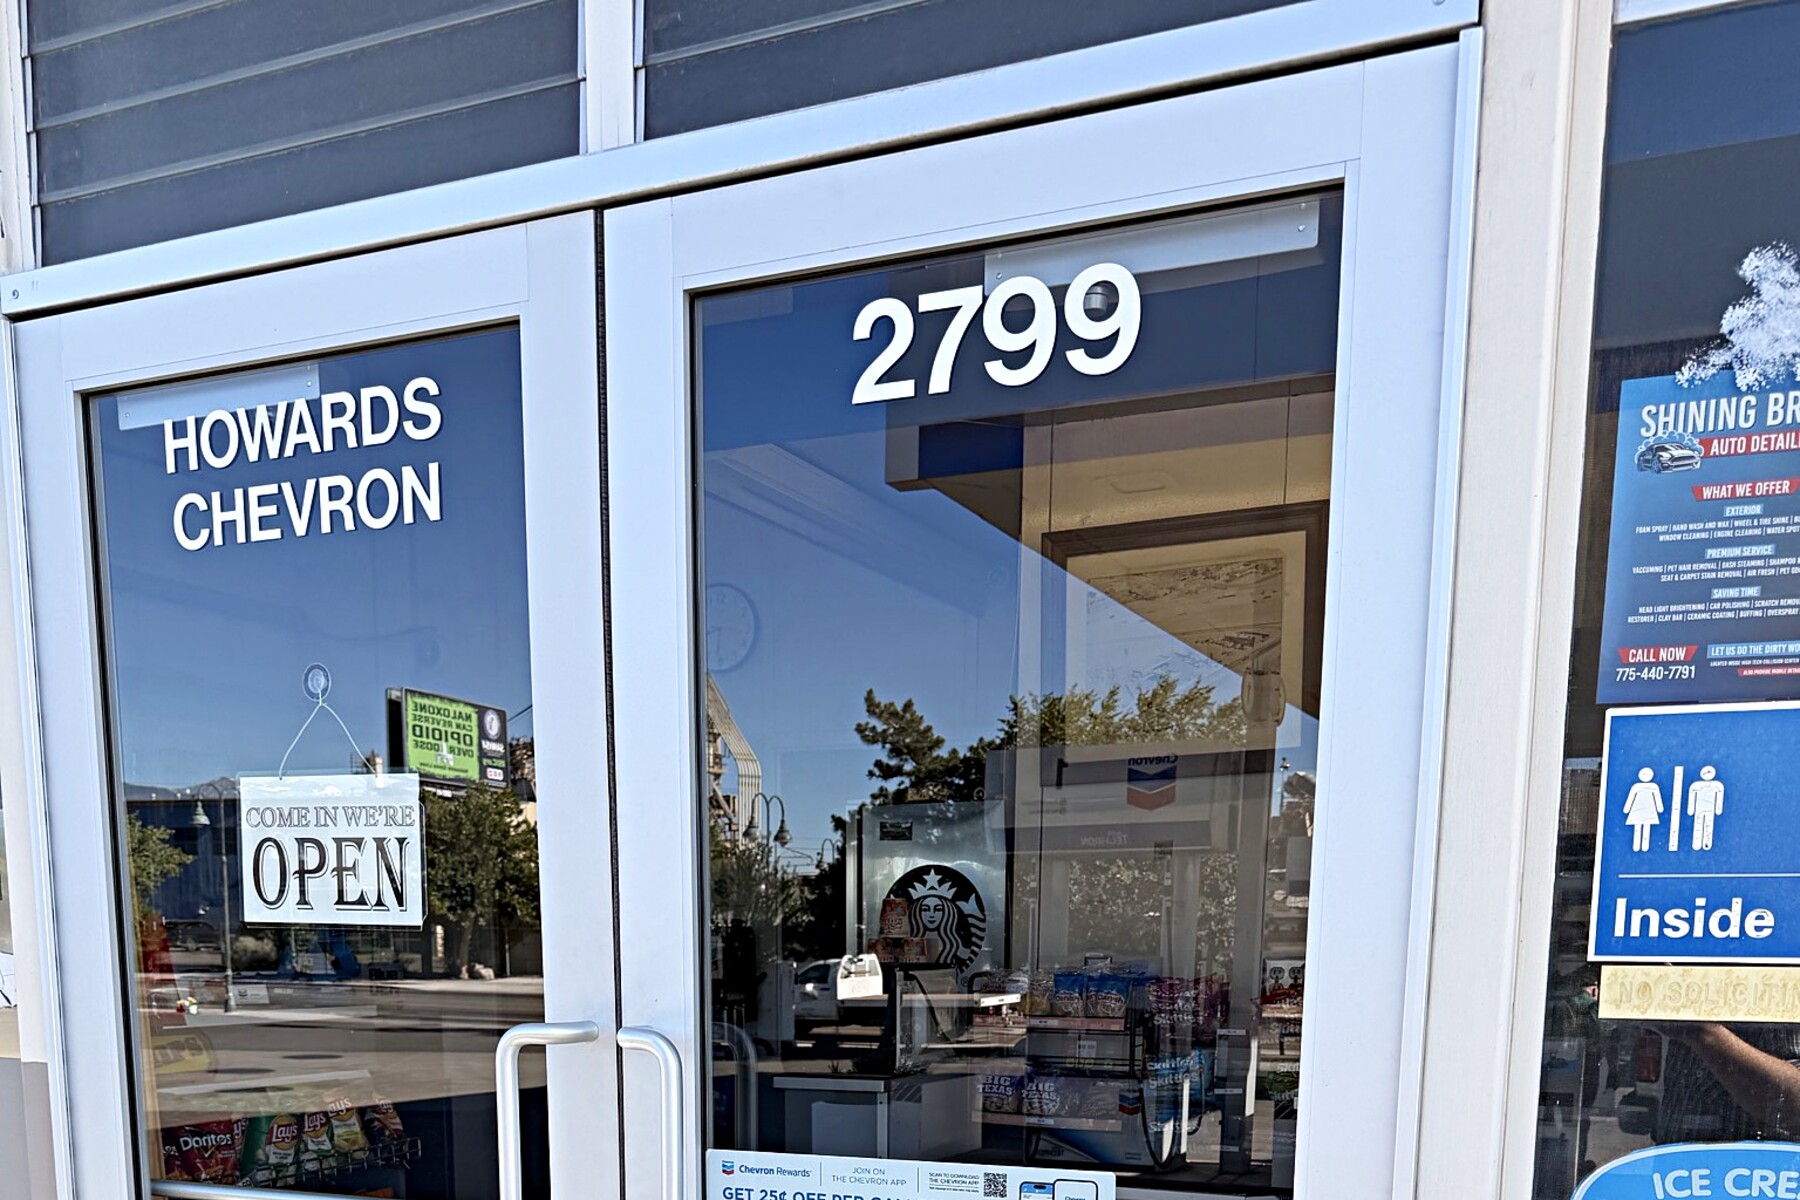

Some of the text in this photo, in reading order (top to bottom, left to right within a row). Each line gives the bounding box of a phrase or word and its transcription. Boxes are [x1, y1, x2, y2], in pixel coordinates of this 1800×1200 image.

[852, 262, 1142, 405] 2799
[1640, 395, 1758, 437] SHINING
[164, 377, 442, 475] HOWARDS
[1710, 436, 1747, 456] AUTO
[1702, 480, 1790, 500] WHAT WE OFFER
[173, 462, 441, 551] CHEVRON
[1726, 505, 1761, 516] EXTERIOR
[1707, 545, 1774, 559] PREMIUM SERVICE
[1713, 586, 1759, 599] SAVING TIME
[1628, 646, 1687, 663] CALL NOW
[1711, 646, 1724, 656] LET
[1725, 646, 1736, 655] US
[1737, 645, 1747, 655] DO
[1749, 645, 1763, 654] THE
[1764, 644, 1786, 653] DIRTY
[1615, 664, 1696, 682] 775-440-7791
[246, 805, 416, 828] COME IN WE'RE
[253, 836, 410, 912] OPEN
[1614, 897, 1775, 938] Inside
[983, 1075, 1011, 1086] BIG
[977, 1085, 1013, 1096] TEXAS
[272, 1121, 298, 1142] Lay's
[304, 1113, 326, 1132] Lay's
[179, 1133, 233, 1151] Doritos
[738, 1164, 812, 1178] Chevron Rewards
[852, 1166, 871, 1175] JOIN
[832, 1174, 907, 1187] THE CHEVRON APP
[1653, 1167, 1800, 1200] ICE CRE
